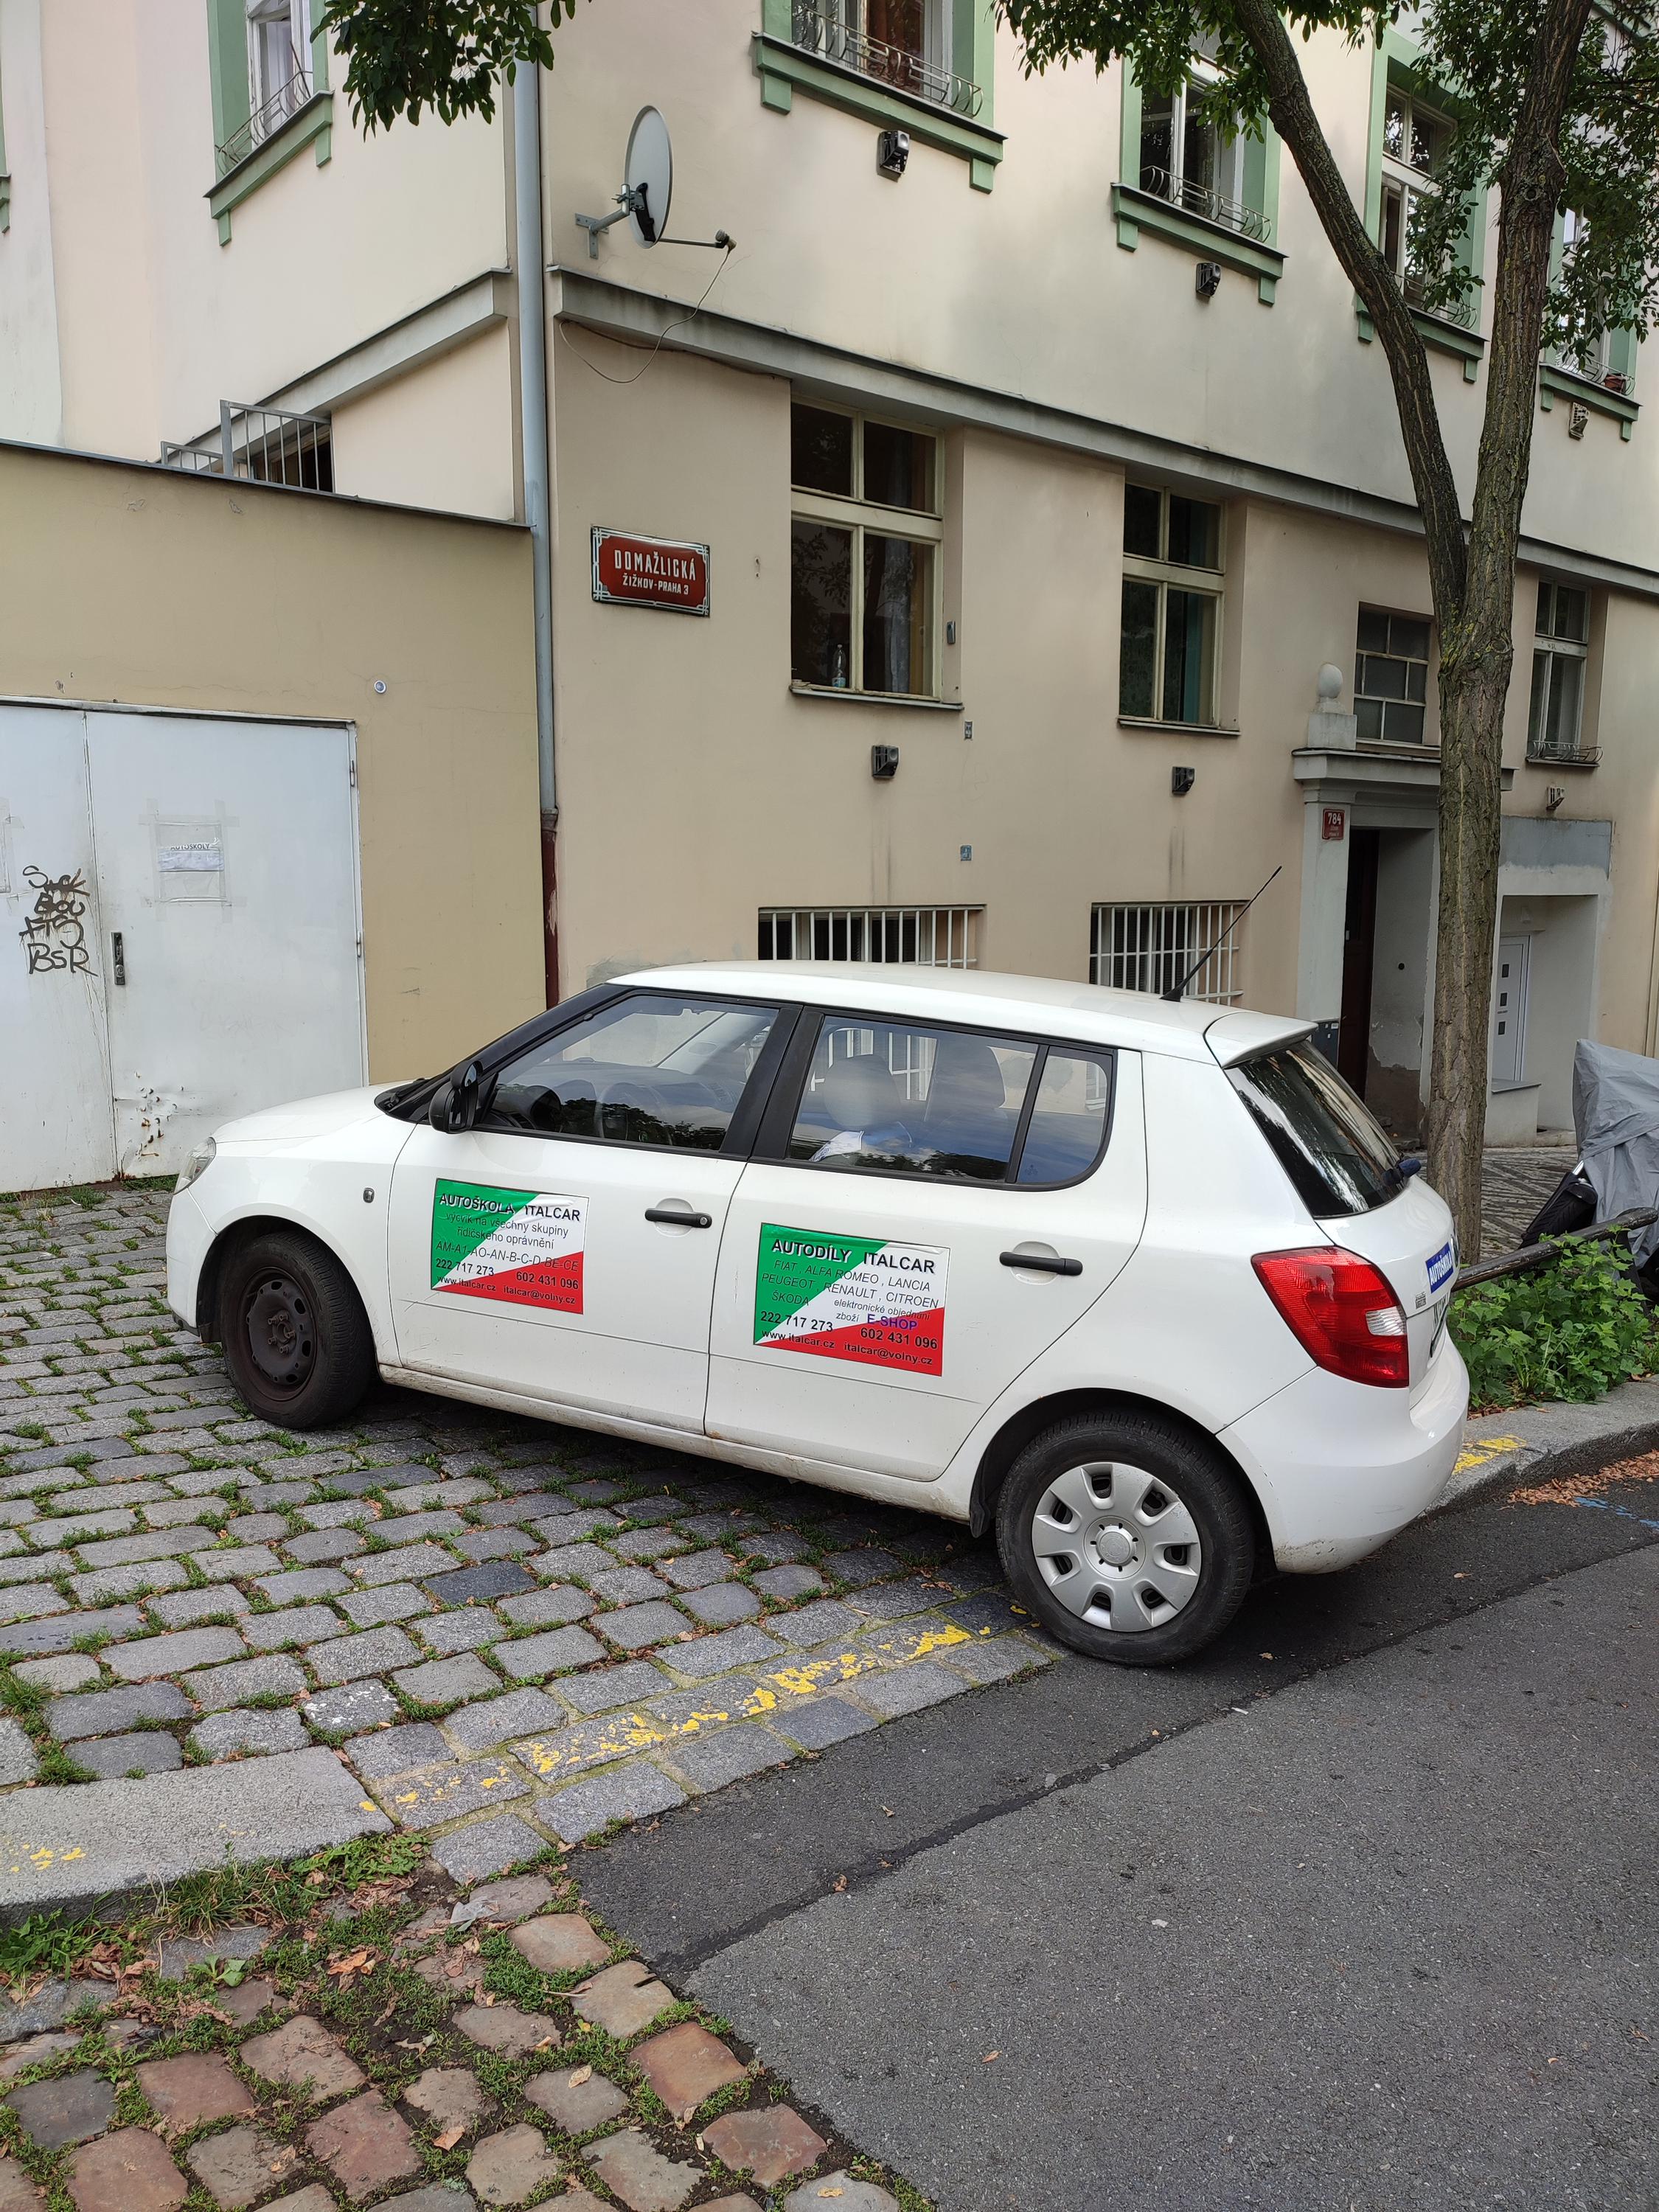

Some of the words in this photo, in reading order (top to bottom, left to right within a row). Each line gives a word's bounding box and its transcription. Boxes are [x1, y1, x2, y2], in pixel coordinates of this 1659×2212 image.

[614, 549, 696, 580] DOMAŽLICKÁ
[684, 585, 689, 595] 3
[1328, 813, 1341, 825] 784
[439, 1193, 515, 1214] AUTOŠKOLA
[525, 1205, 580, 1221] ITALCAR
[476, 1217, 487, 1226] na
[490, 1218, 529, 1234] všechny
[532, 1222, 568, 1239] skupiny
[507, 1234, 554, 1250] oprávnění
[772, 1239, 852, 1263] AUTODÍLY
[863, 1251, 936, 1274] ITALCAR
[436, 1258, 453, 1269] 222
[456, 1262, 473, 1273] 717
[476, 1265, 494, 1276] 273
[516, 1271, 535, 1283] 602
[538, 1274, 556, 1286] 431
[560, 1278, 579, 1290] 096
[762, 1273, 815, 1289] PEUGEOT
[824, 1282, 877, 1299] RENAULT
[774, 1259, 798, 1272] FIAT
[805, 1265, 832, 1277] ALFA
[835, 1269, 879, 1284] ROMEO
[888, 1276, 931, 1293] LANCIA
[437, 1276, 496, 1291] www.italcar.cz
[503, 1285, 575, 1305] italcar@volny.cz
[771, 1290, 809, 1306] ŠKODA
[834, 1298, 886, 1313] elektronické
[761, 1311, 782, 1324] 222
[785, 1314, 807, 1329] 717
[811, 1318, 833, 1332] 273
[860, 1327, 883, 1340] 602
[888, 1332, 910, 1345] 431
[915, 1336, 937, 1349] 096
[835, 1312, 860, 1322] zboží
[867, 1313, 917, 1330] E-SHOP
[762, 1330, 835, 1348] www.italcar.cz
[843, 1342, 932, 1365] italcar@volny.cz
